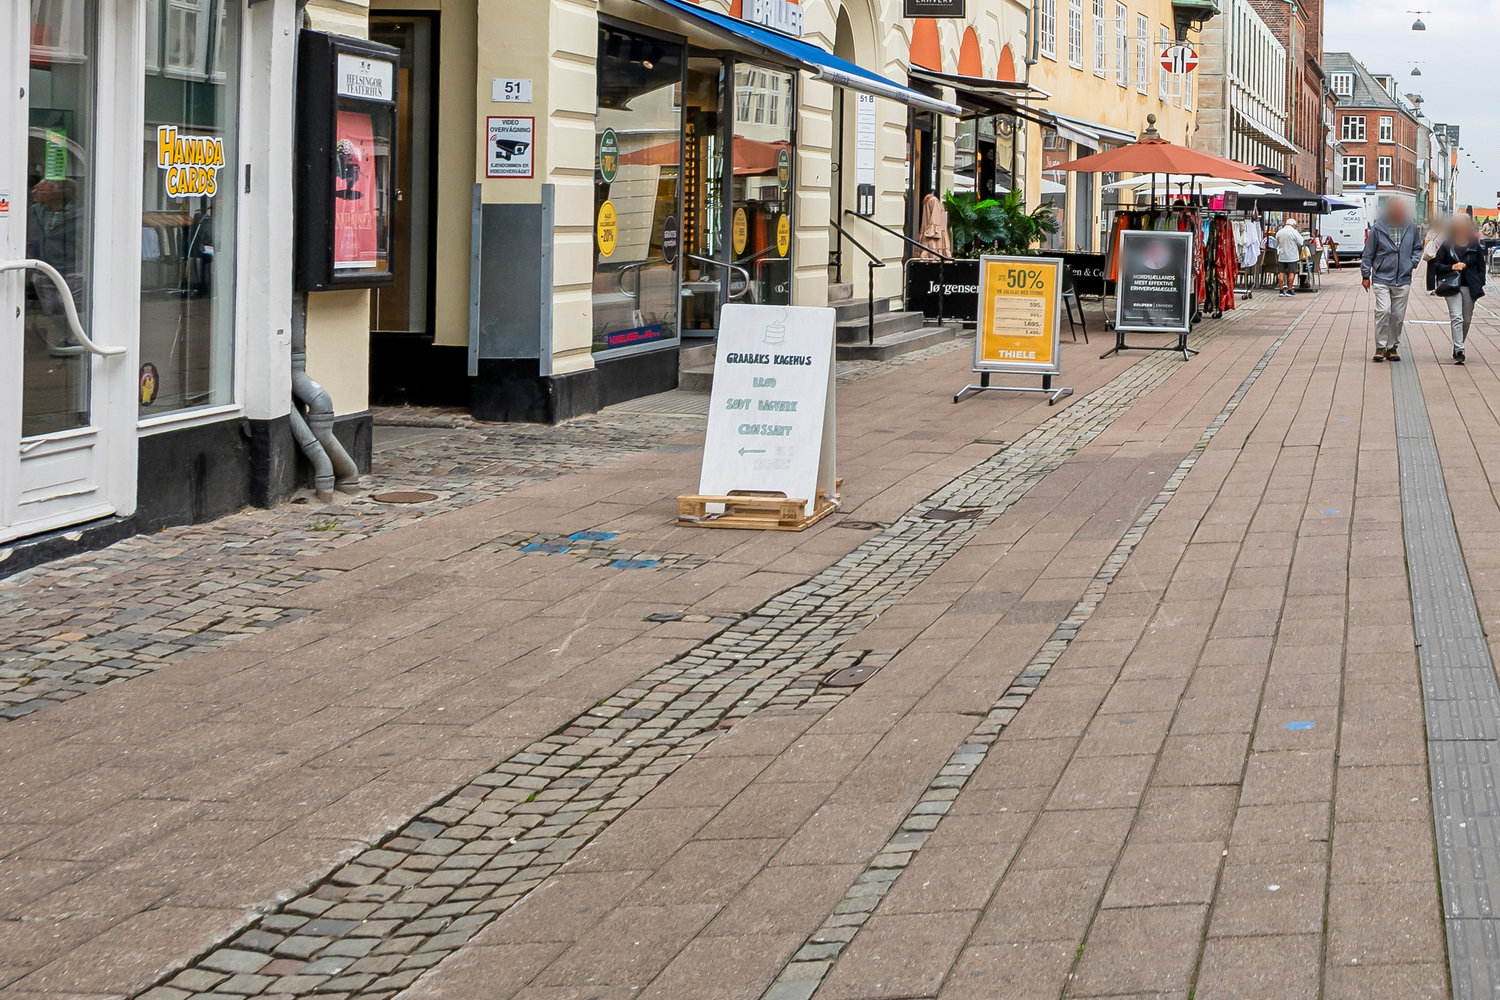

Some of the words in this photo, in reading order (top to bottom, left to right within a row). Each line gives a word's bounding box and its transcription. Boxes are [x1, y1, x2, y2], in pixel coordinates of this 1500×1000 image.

[346, 84, 382, 98] TEATERHUS
[504, 81, 521, 94] 51
[860, 94, 868, 102] 51
[869, 95, 874, 103] B
[158, 128, 224, 166] HANADA
[167, 166, 216, 195] CARDS
[1007, 269, 1044, 289] 50%
[774, 354, 812, 366] KAGEHUS
[998, 350, 1036, 359] THIELE
[738, 424, 793, 436] CROISSANT
